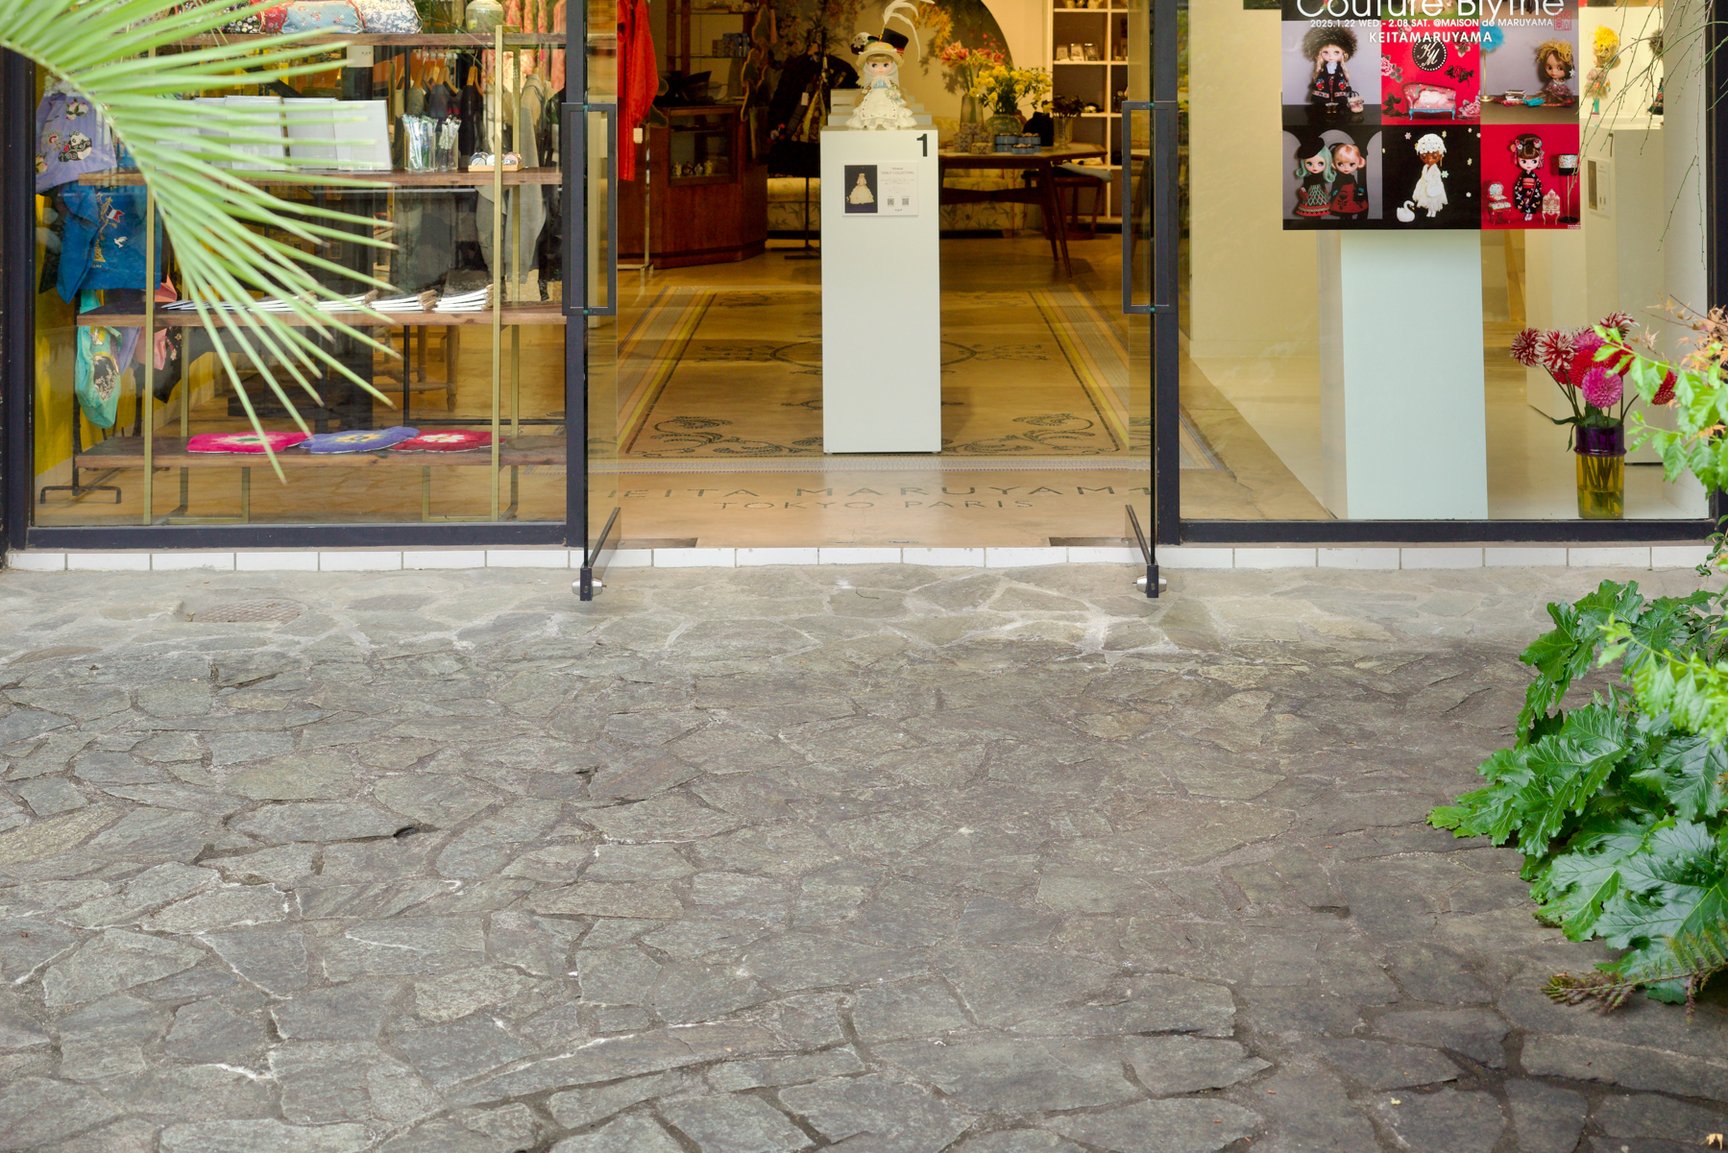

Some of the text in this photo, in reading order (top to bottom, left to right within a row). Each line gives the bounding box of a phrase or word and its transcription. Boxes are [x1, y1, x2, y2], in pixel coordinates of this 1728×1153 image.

[1310, 19, 1356, 28] 2025.1.22
[1388, 19, 1408, 28] 2.08
[1411, 18, 1431, 27] SAT.
[1433, 18, 1479, 27] @MAISON
[1482, 18, 1495, 27] de
[1497, 18, 1553, 27] MARUYAMA
[1369, 31, 1492, 43] KEITAMARUYAMA
[916, 133, 928, 157] 1
[904, 500, 1033, 508] PARIS
